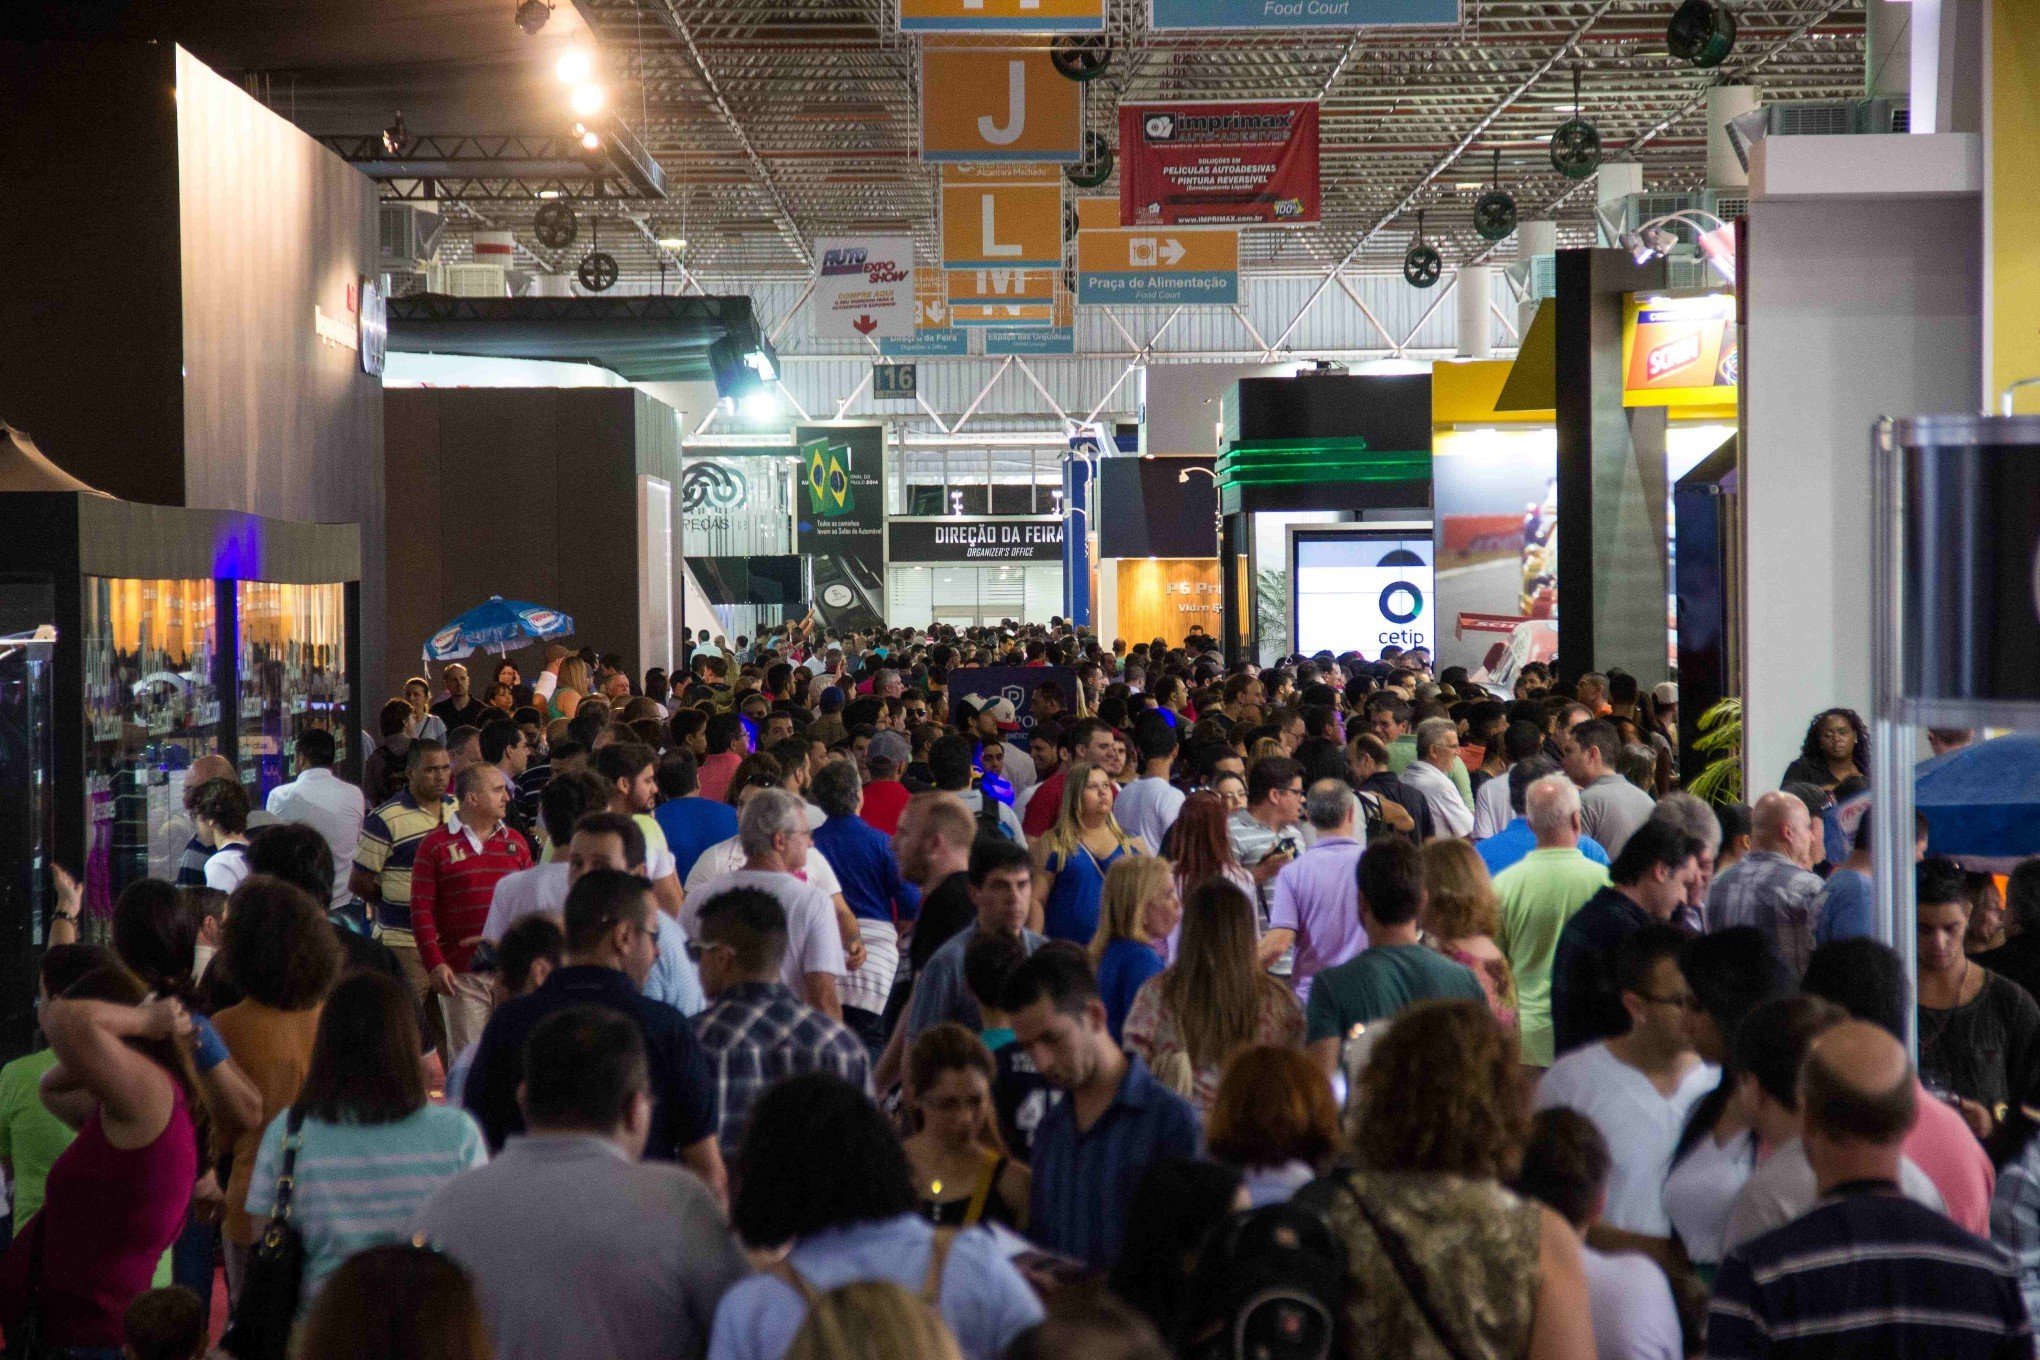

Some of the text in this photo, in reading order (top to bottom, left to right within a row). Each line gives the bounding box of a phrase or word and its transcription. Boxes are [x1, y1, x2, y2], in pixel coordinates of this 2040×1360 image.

[1264, 0, 1350, 16] Food Court
[977, 61, 1026, 144] J
[1013, 167, 1047, 177] Machado
[1163, 164, 1277, 175] PELÍCULAS AUTOADESIVAS
[1177, 176, 1215, 186] PINTURA
[1217, 173, 1269, 184] REVERSÍVEL
[1177, 214, 1264, 223] www.IMPRIMAX.com.br
[982, 194, 1023, 257] L
[823, 248, 868, 267] AUTO
[863, 261, 896, 274] EXPO
[869, 270, 910, 284] SHOW
[1088, 275, 1228, 290] Praça de Alimentação
[1135, 290, 1182, 299] Food Court
[936, 333, 958, 343] Feira
[884, 365, 914, 390] 16
[935, 523, 1064, 547] DIREÇÃO DA FEIRA
[966, 546, 1035, 558] ORGANIZER'S OFFICE
[1177, 603, 1210, 613] Vidro
[1378, 629, 1424, 649] cetip
